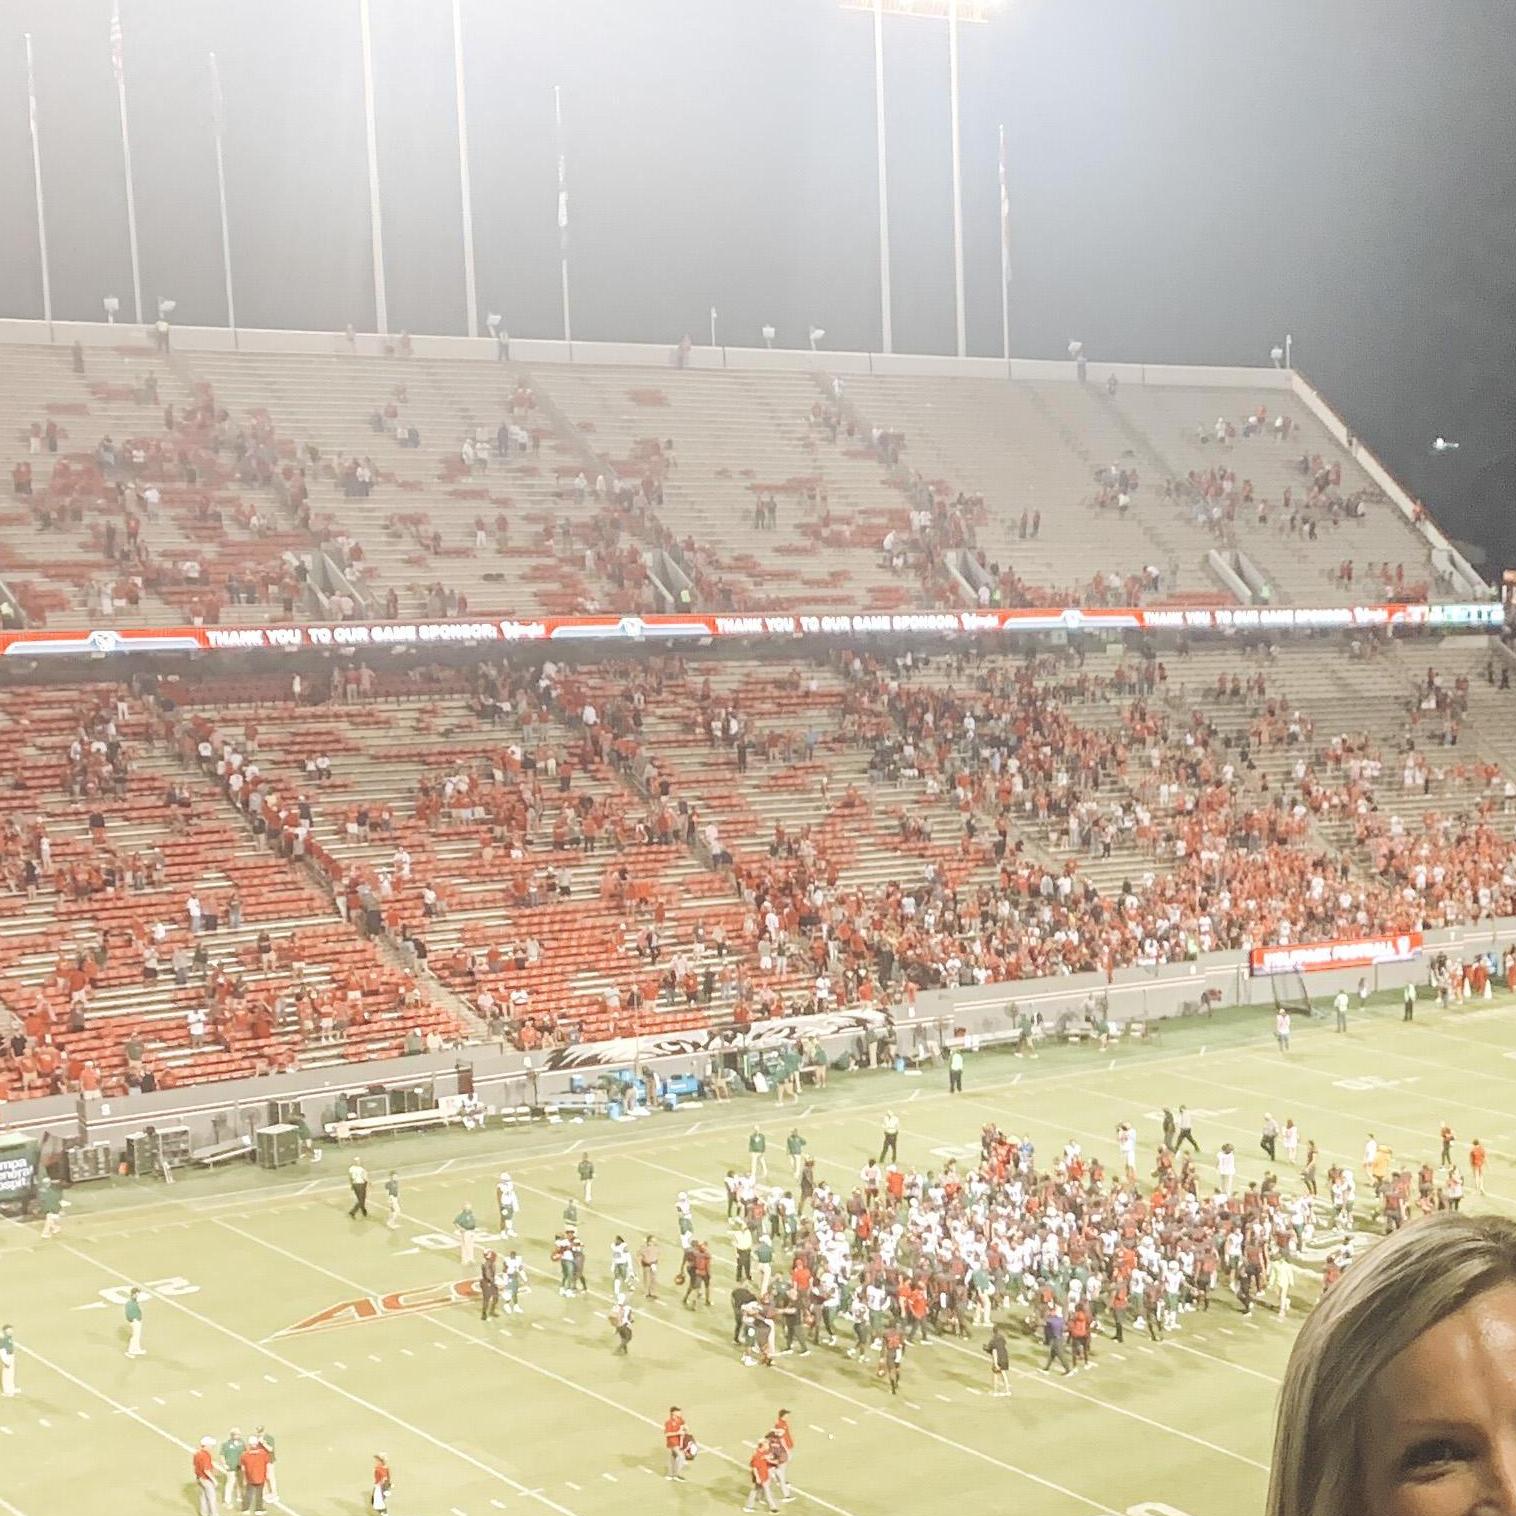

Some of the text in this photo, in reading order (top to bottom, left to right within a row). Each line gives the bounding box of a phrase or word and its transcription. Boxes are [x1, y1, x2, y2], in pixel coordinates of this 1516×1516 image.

[716, 617, 763, 633] THANK
[765, 617, 794, 633] YOU
[800, 616, 820, 632] TO
[821, 615, 850, 632] OUR
[206, 629, 264, 647] THANK
[266, 628, 301, 646] YOU
[308, 628, 332, 644] TO
[333, 626, 371, 644] OUR
[371, 624, 416, 642] GAME
[0, 1158, 27, 1173] mpa
